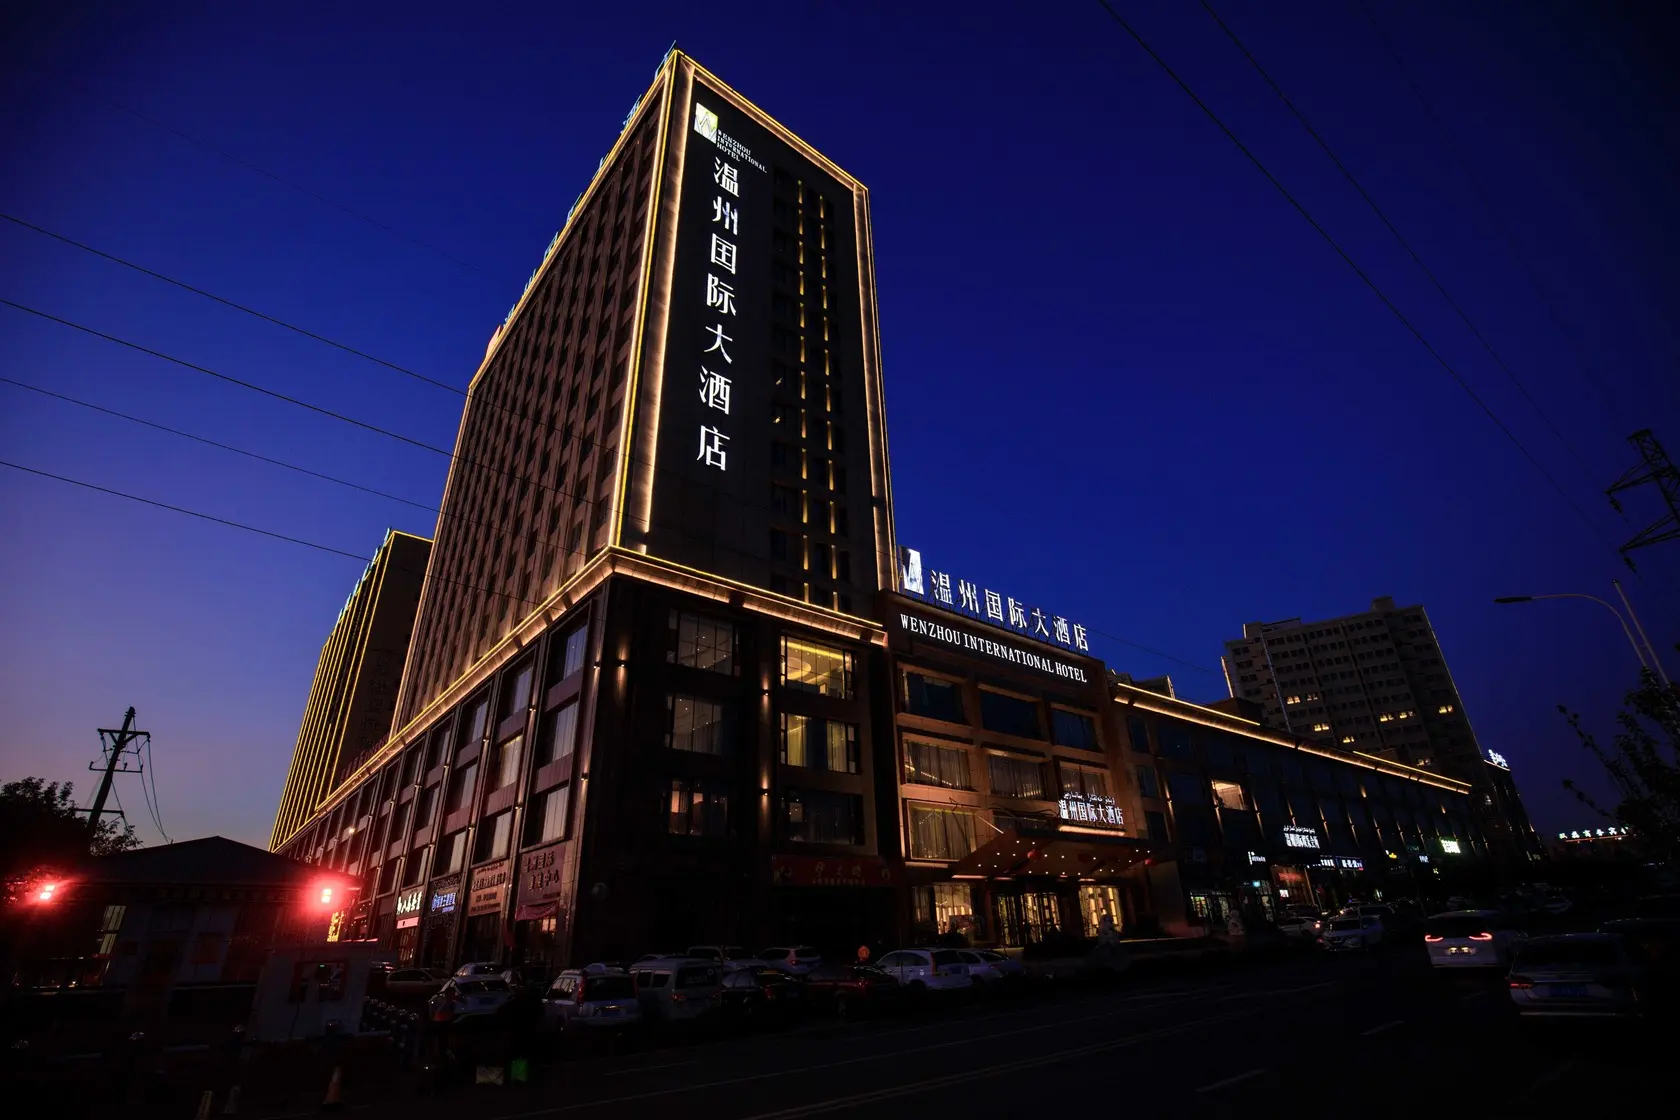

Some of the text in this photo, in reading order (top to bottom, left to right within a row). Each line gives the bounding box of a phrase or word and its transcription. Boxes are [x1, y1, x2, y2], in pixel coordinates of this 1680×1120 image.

[716, 142, 740, 161] HOTEL
[717, 136, 768, 173] INTERNATIONAL
[696, 156, 739, 471] 温州国际大酒店
[931, 569, 1089, 651] 温州国际大酒店
[900, 613, 1087, 683] WENZHOU INTERNATIONAL HOTEL
[1058, 799, 1124, 825] 温州国际大酒店
